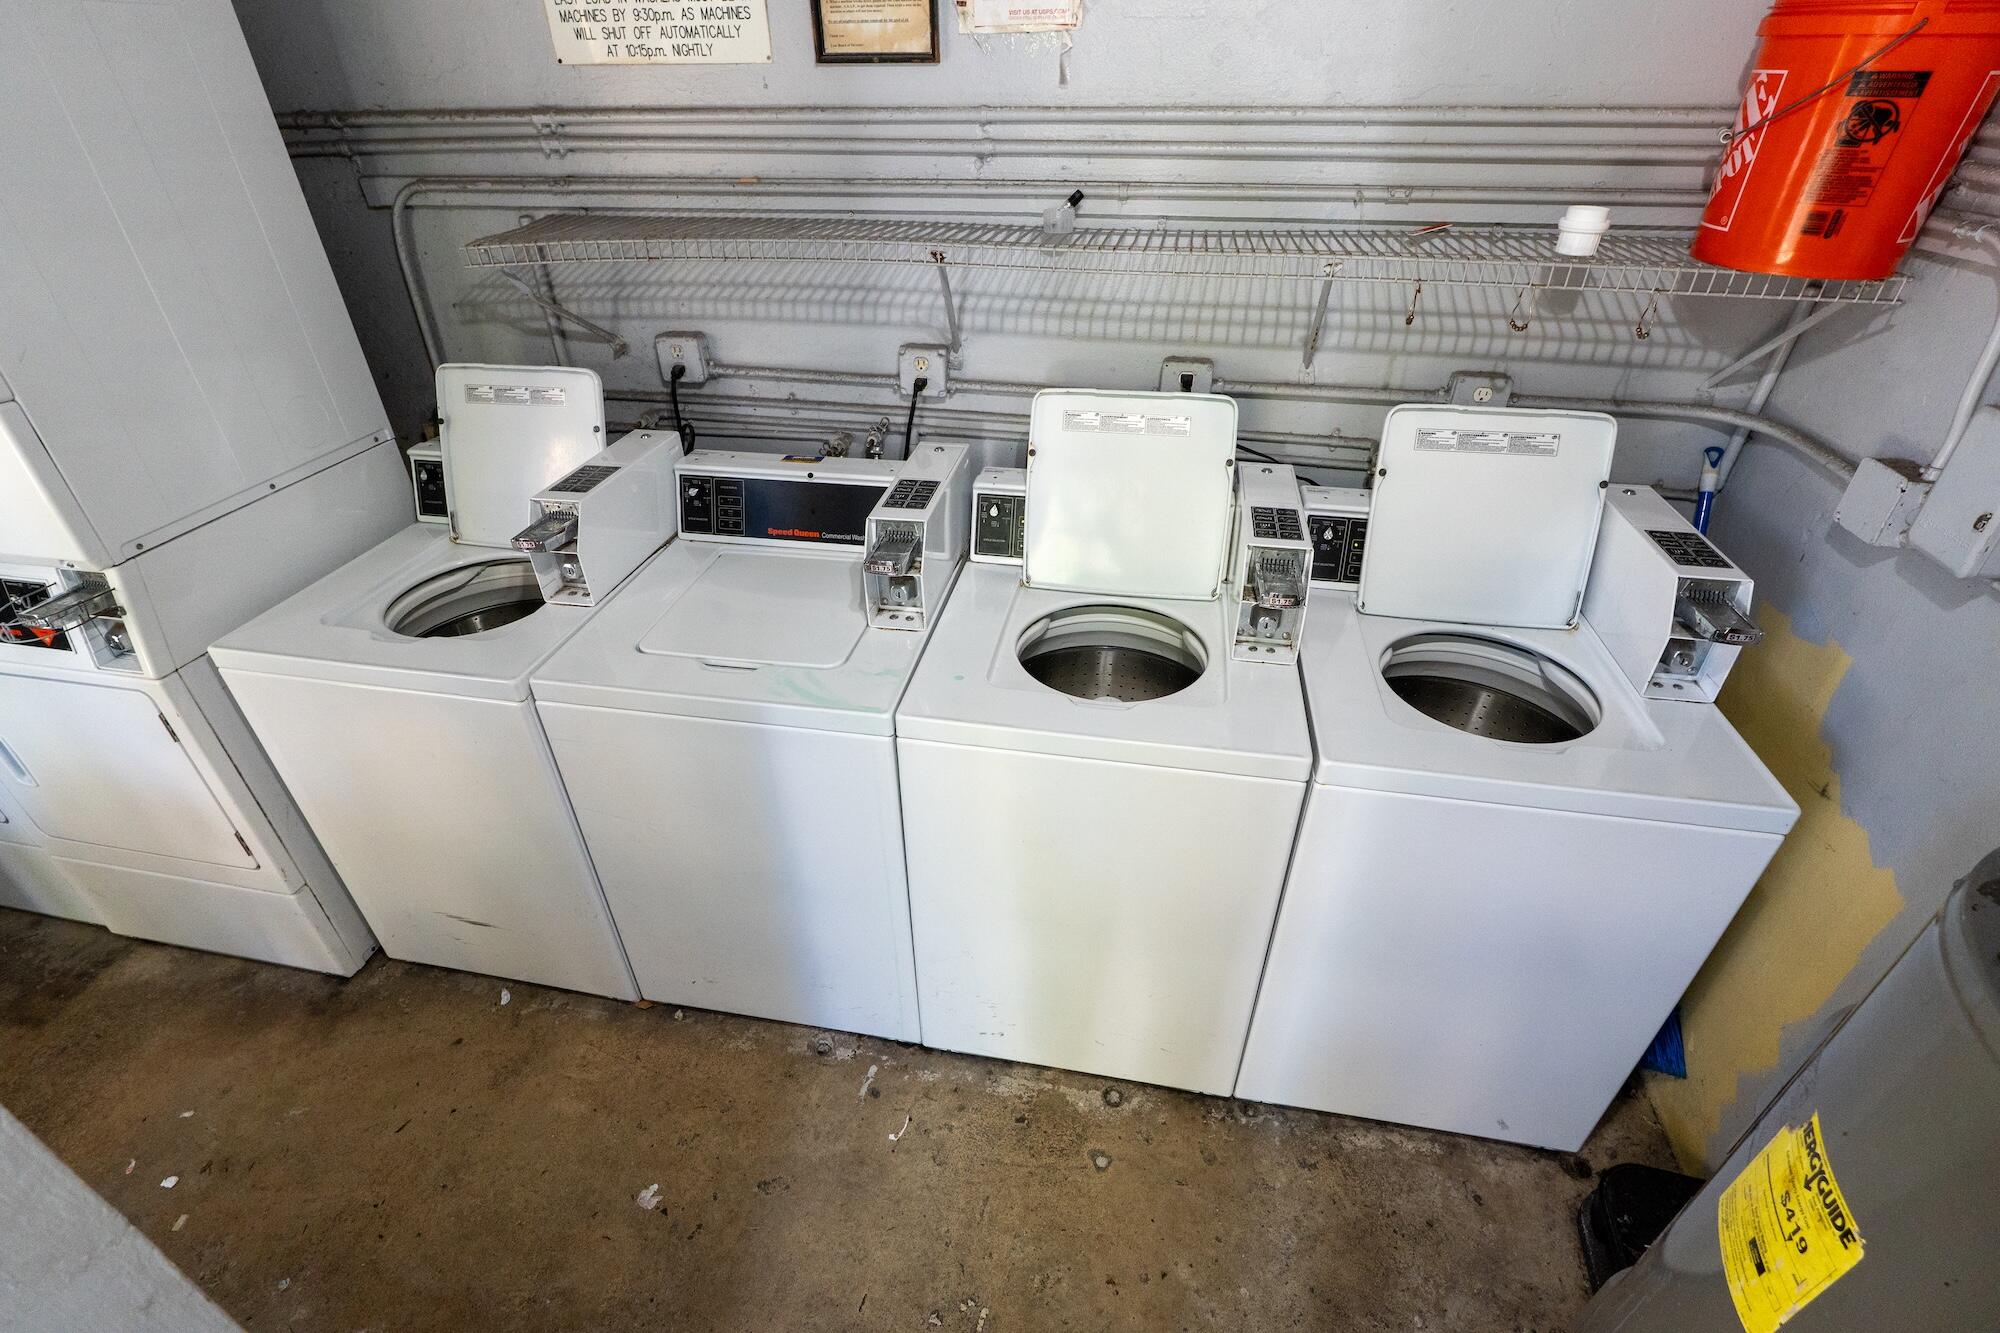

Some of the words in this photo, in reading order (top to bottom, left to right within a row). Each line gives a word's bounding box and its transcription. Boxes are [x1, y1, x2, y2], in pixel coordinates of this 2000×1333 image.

[559, 8, 608, 23] MACHINES
[612, 8, 626, 22] BY
[681, 7, 695, 21] AS
[700, 5, 752, 20] MACHINES
[573, 26, 597, 40] WILL
[602, 26, 627, 40] SHUT
[633, 26, 652, 40] OFF
[660, 24, 742, 39] AUTOMATICALLY
[607, 44, 618, 57] AT
[672, 42, 713, 57] NIGHTLY
[767, 527, 793, 536] Speed
[794, 529, 820, 538] Queen
[821, 531, 852, 540] Commercial
[1780, 1190, 1809, 1255] $419
